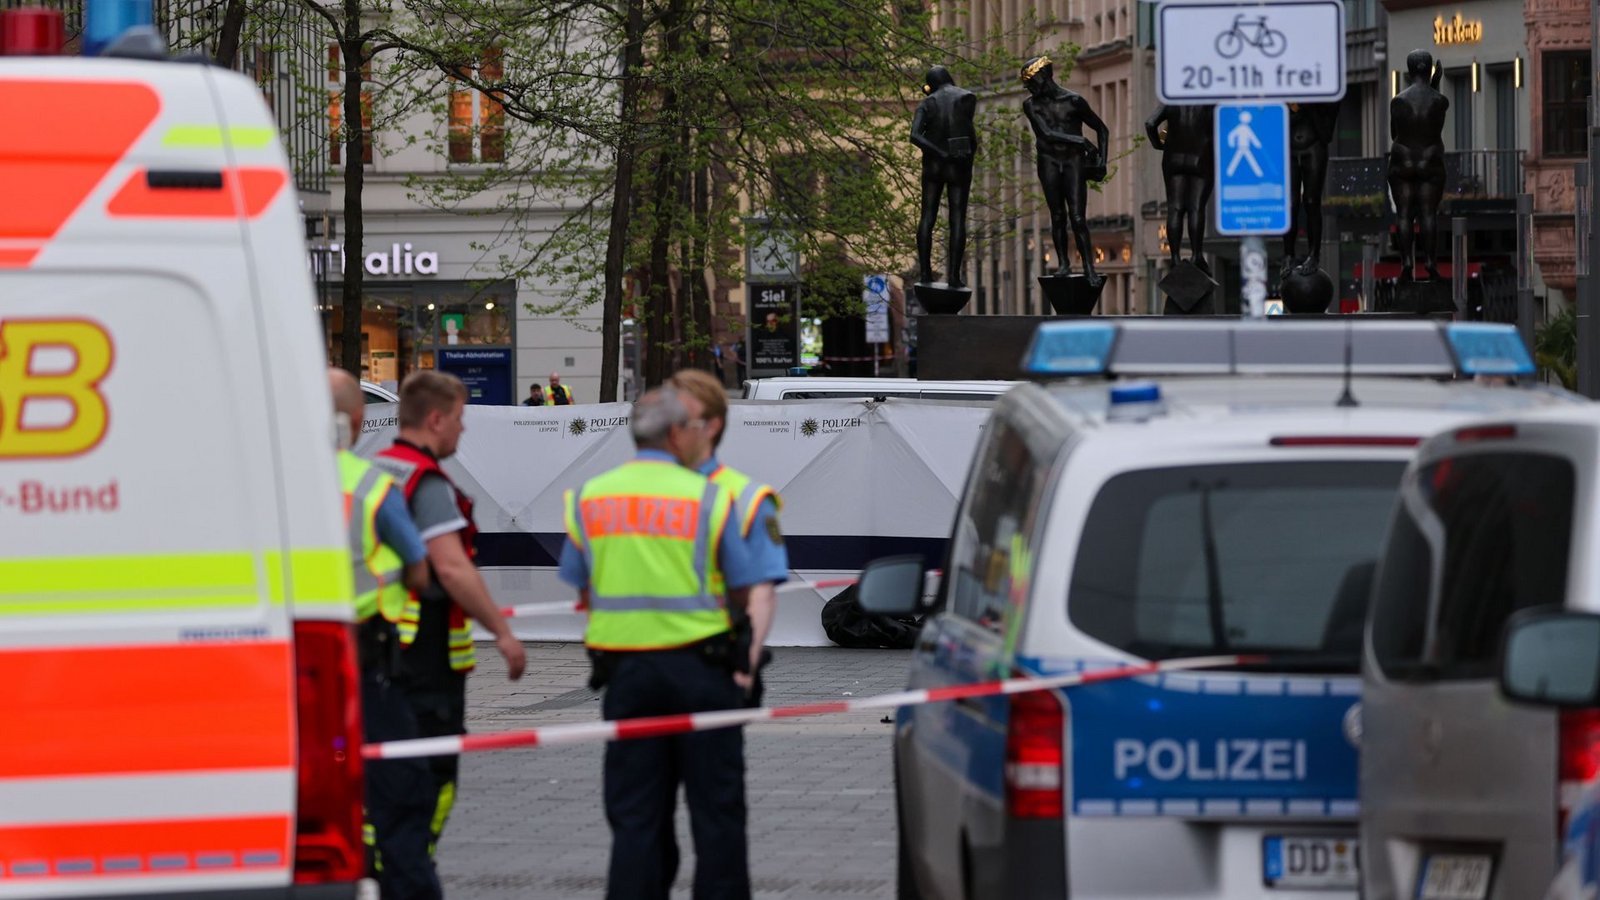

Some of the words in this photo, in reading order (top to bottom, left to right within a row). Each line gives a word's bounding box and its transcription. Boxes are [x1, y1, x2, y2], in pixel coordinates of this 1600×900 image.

[1182, 65, 1263, 89] 20-11h
[1276, 63, 1322, 87] frei
[761, 289, 786, 302] Sie!
[0, 317, 116, 461] B
[363, 417, 398, 428] POLIZEI
[590, 417, 628, 428] POLIZEI
[822, 418, 861, 428] POLIZEI
[588, 496, 694, 536] POLIZEI
[1114, 738, 1307, 781] POLIZEI
